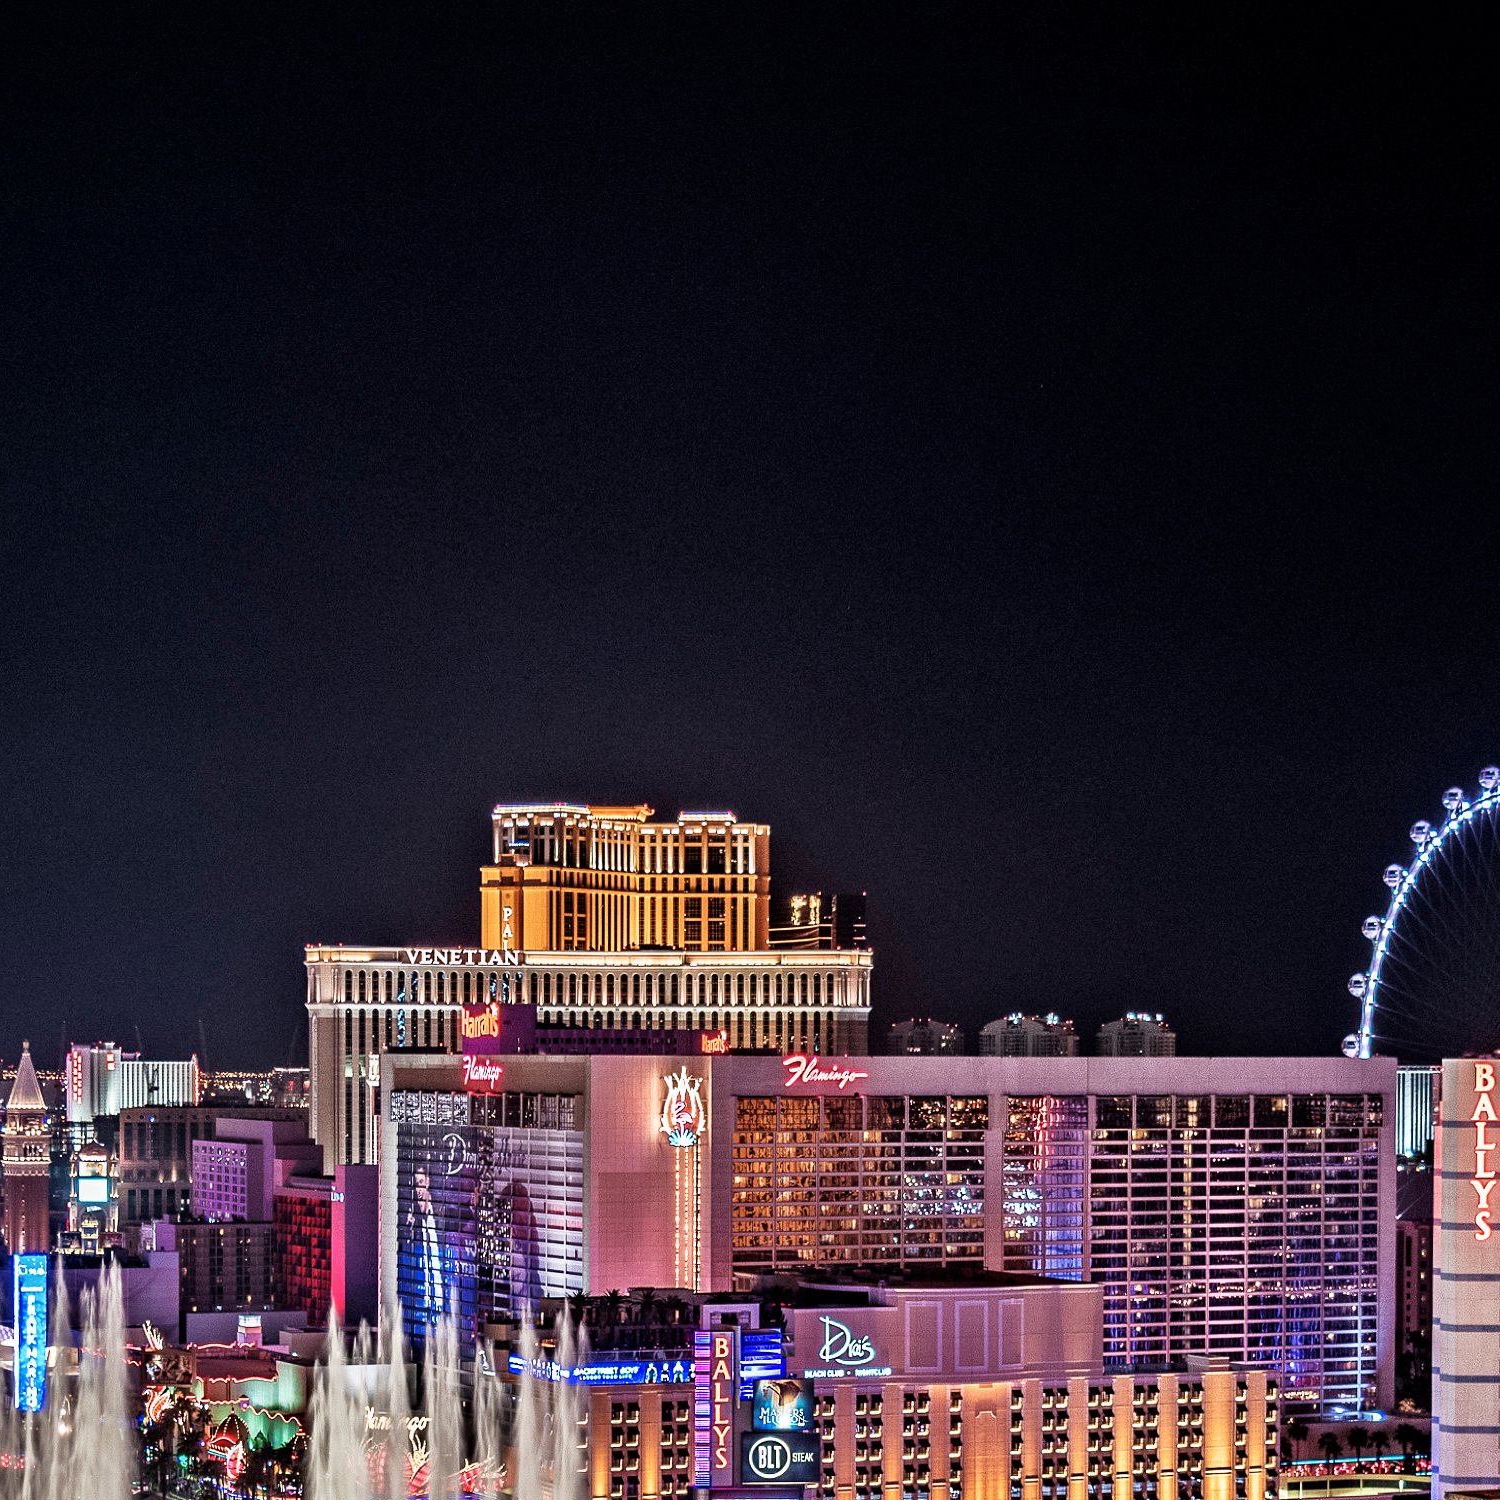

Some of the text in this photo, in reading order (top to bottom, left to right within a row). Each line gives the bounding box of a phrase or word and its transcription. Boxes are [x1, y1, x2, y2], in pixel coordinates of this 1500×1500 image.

[404, 948, 520, 966] VENETIAN
[463, 1055, 503, 1089] Flamingo
[782, 1055, 869, 1090] Flamingo
[804, 1367, 892, 1378] BEACH CLUB NIGHTCLUB
[712, 1337, 731, 1469] BALLYS
[758, 1445, 782, 1469] BLT
[792, 1452, 814, 1463] STEAK
